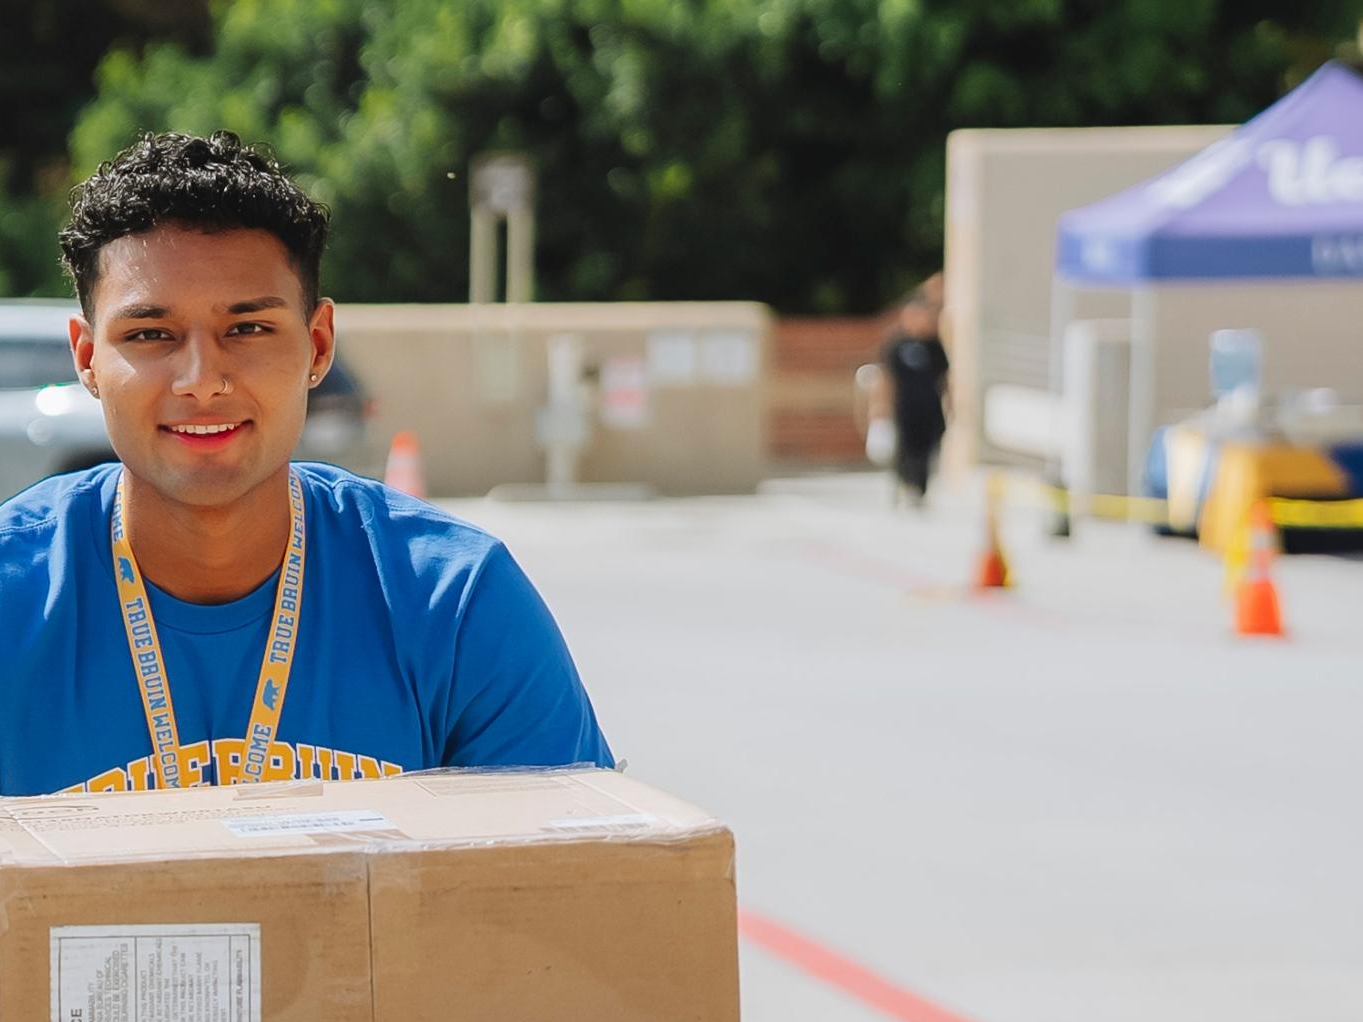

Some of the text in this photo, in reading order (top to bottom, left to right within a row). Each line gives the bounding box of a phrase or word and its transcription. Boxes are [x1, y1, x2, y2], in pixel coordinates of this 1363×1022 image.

[270, 477, 304, 663] TRUE BRUIN WELCOM
[126, 597, 179, 788] TRUE BRUIN WELCOM
